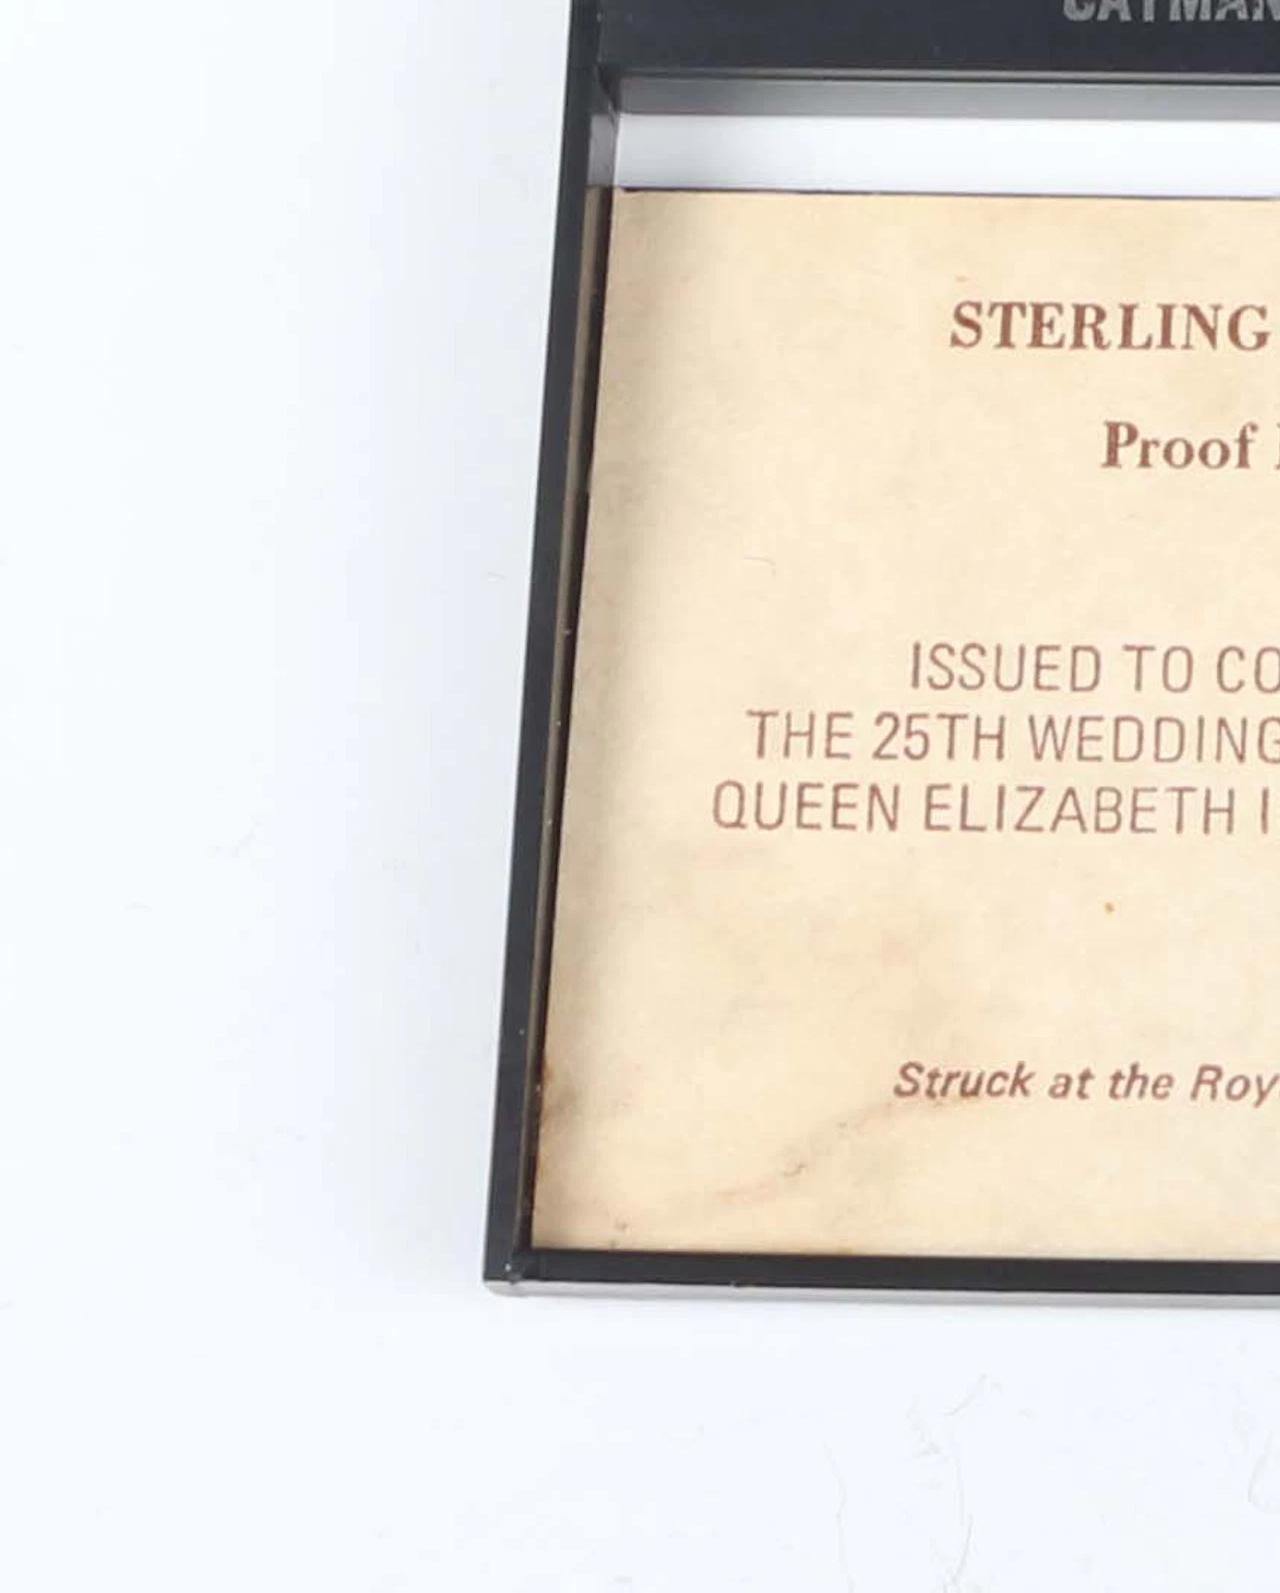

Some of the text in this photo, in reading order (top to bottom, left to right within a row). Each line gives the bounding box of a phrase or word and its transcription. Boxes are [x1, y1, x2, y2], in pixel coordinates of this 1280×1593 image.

[949, 299, 1271, 352] STERLING
[1101, 420, 1259, 470] Proof
[910, 640, 1102, 694] ISSUED
[1121, 643, 1195, 695] TO
[746, 708, 855, 761] THE
[871, 710, 1007, 762] 25TH
[711, 778, 901, 833] QUEEN
[923, 782, 1236, 836] ELIZABETH
[892, 1060, 1036, 1102] Struck
[1047, 1067, 1096, 1101] at
[1107, 1061, 1175, 1101] the
